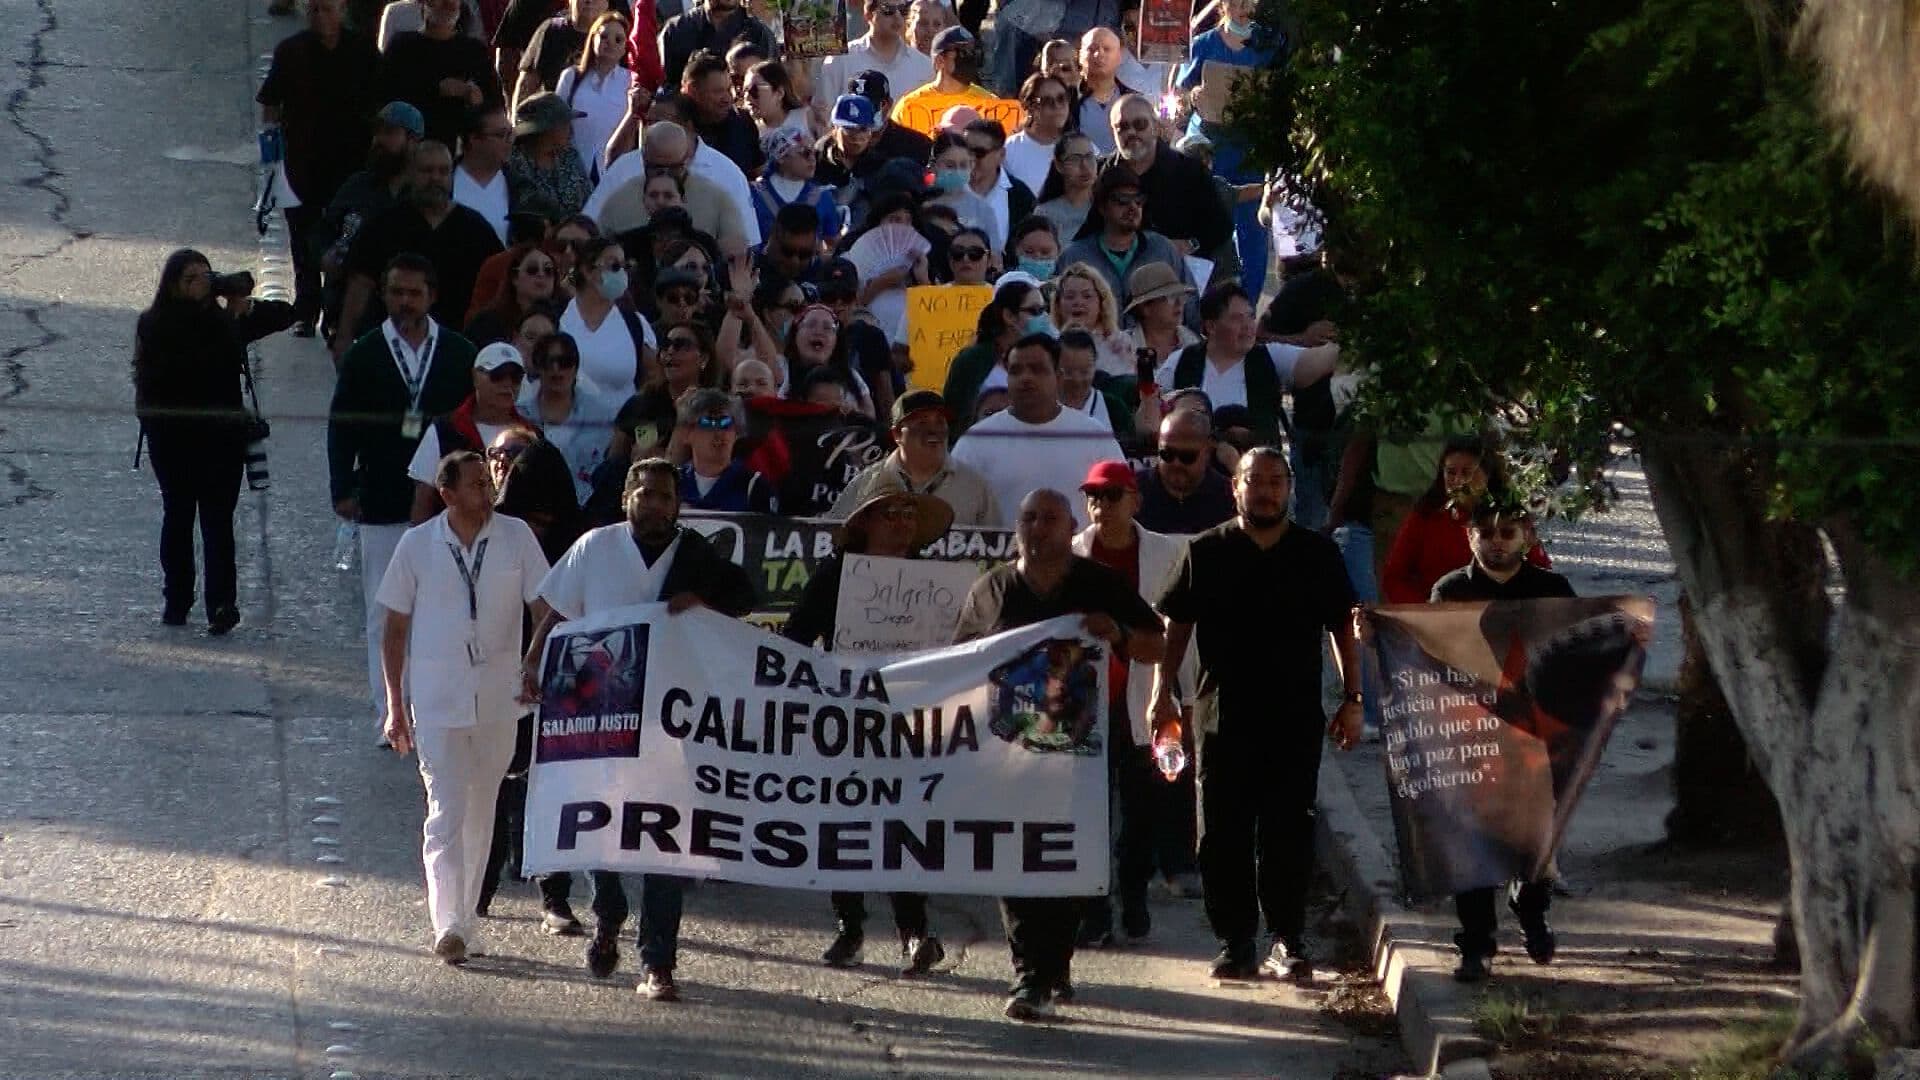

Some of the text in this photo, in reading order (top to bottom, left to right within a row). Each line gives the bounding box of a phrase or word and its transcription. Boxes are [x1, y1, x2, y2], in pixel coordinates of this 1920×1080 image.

[764, 530, 804, 559] LA
[755, 644, 891, 705] BAJA
[1419, 670, 1441, 687] no
[1447, 666, 1481, 687] hay
[1440, 692, 1479, 714] para
[1483, 687, 1498, 704] el
[541, 713, 640, 738] SALARIO JUSTO
[660, 686, 980, 760] CALIFORNIA
[1440, 718, 1473, 740] que
[1478, 716, 1500, 731] no
[1425, 746, 1457, 768] paz
[1460, 741, 1501, 764] para
[695, 764, 945, 807] SECCIÓN 7
[557, 800, 1078, 873] PRESENTE
